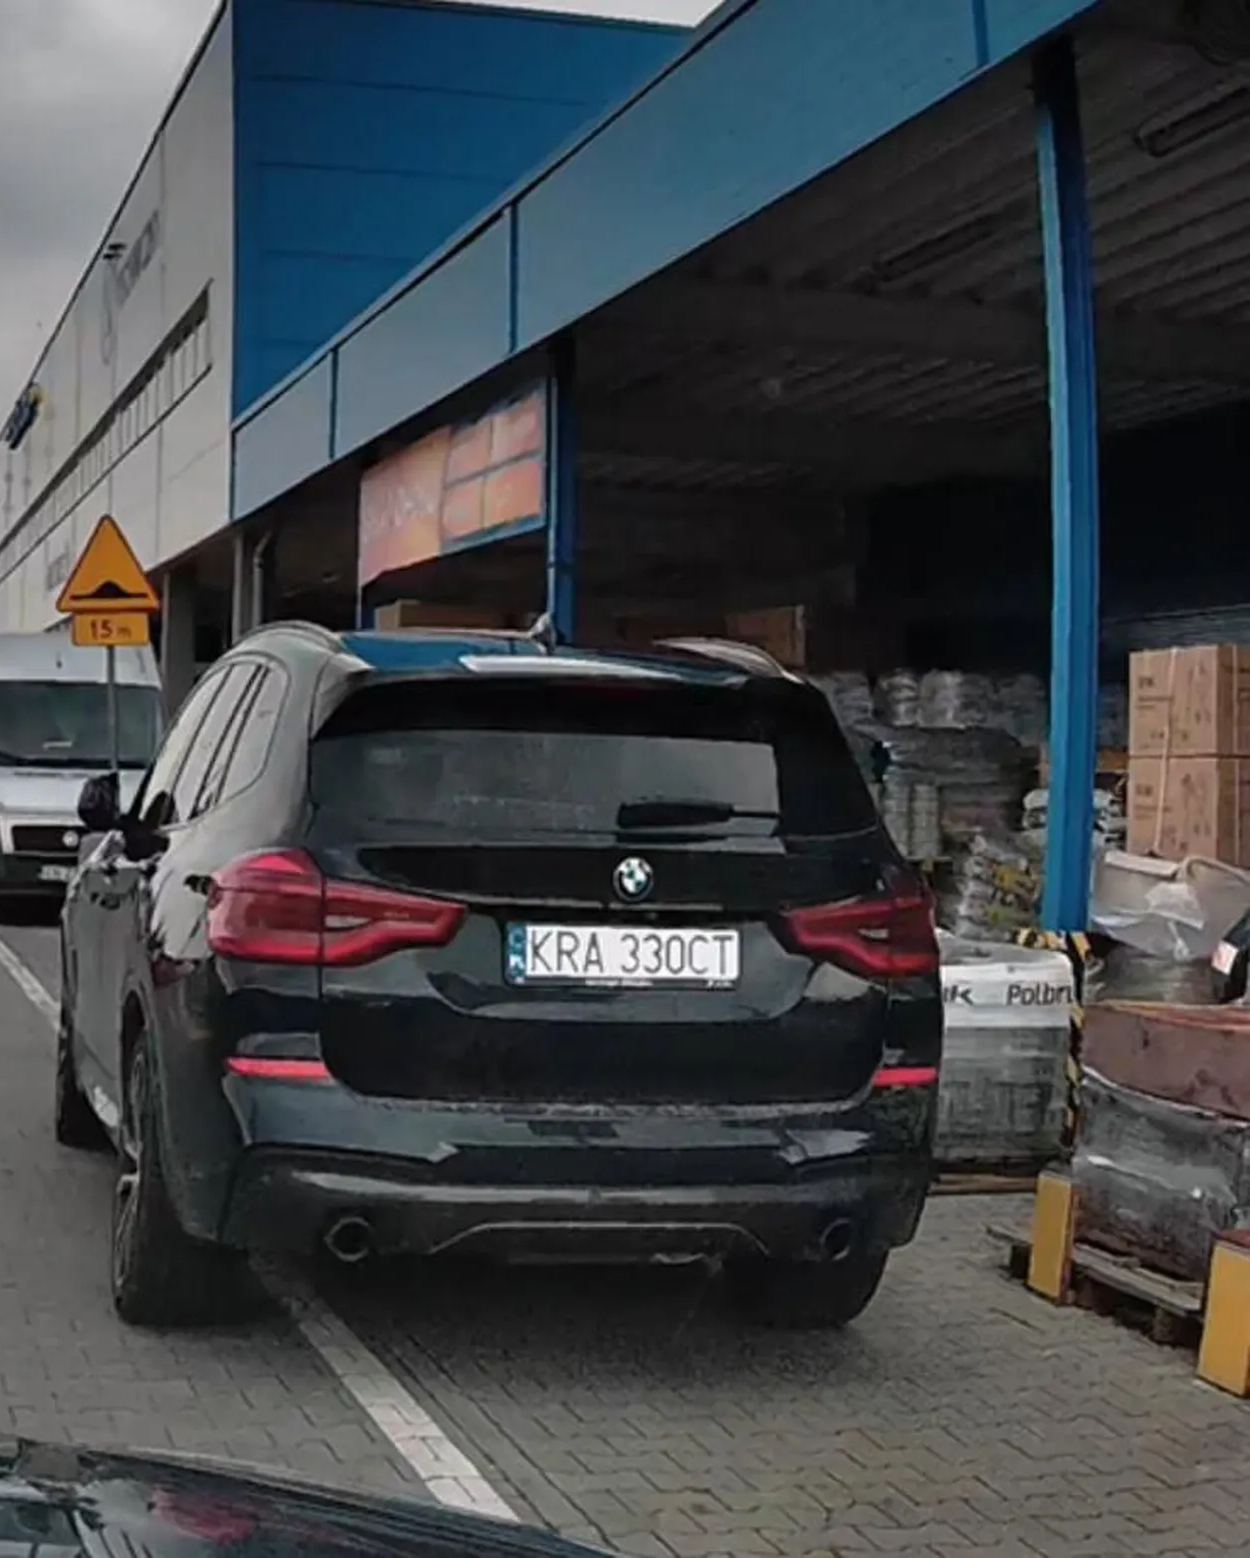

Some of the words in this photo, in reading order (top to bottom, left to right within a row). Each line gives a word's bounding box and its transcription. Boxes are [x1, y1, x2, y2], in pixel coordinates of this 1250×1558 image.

[90, 619, 113, 640] 15
[530, 929, 605, 974] KRA
[620, 933, 734, 976] 330CT
